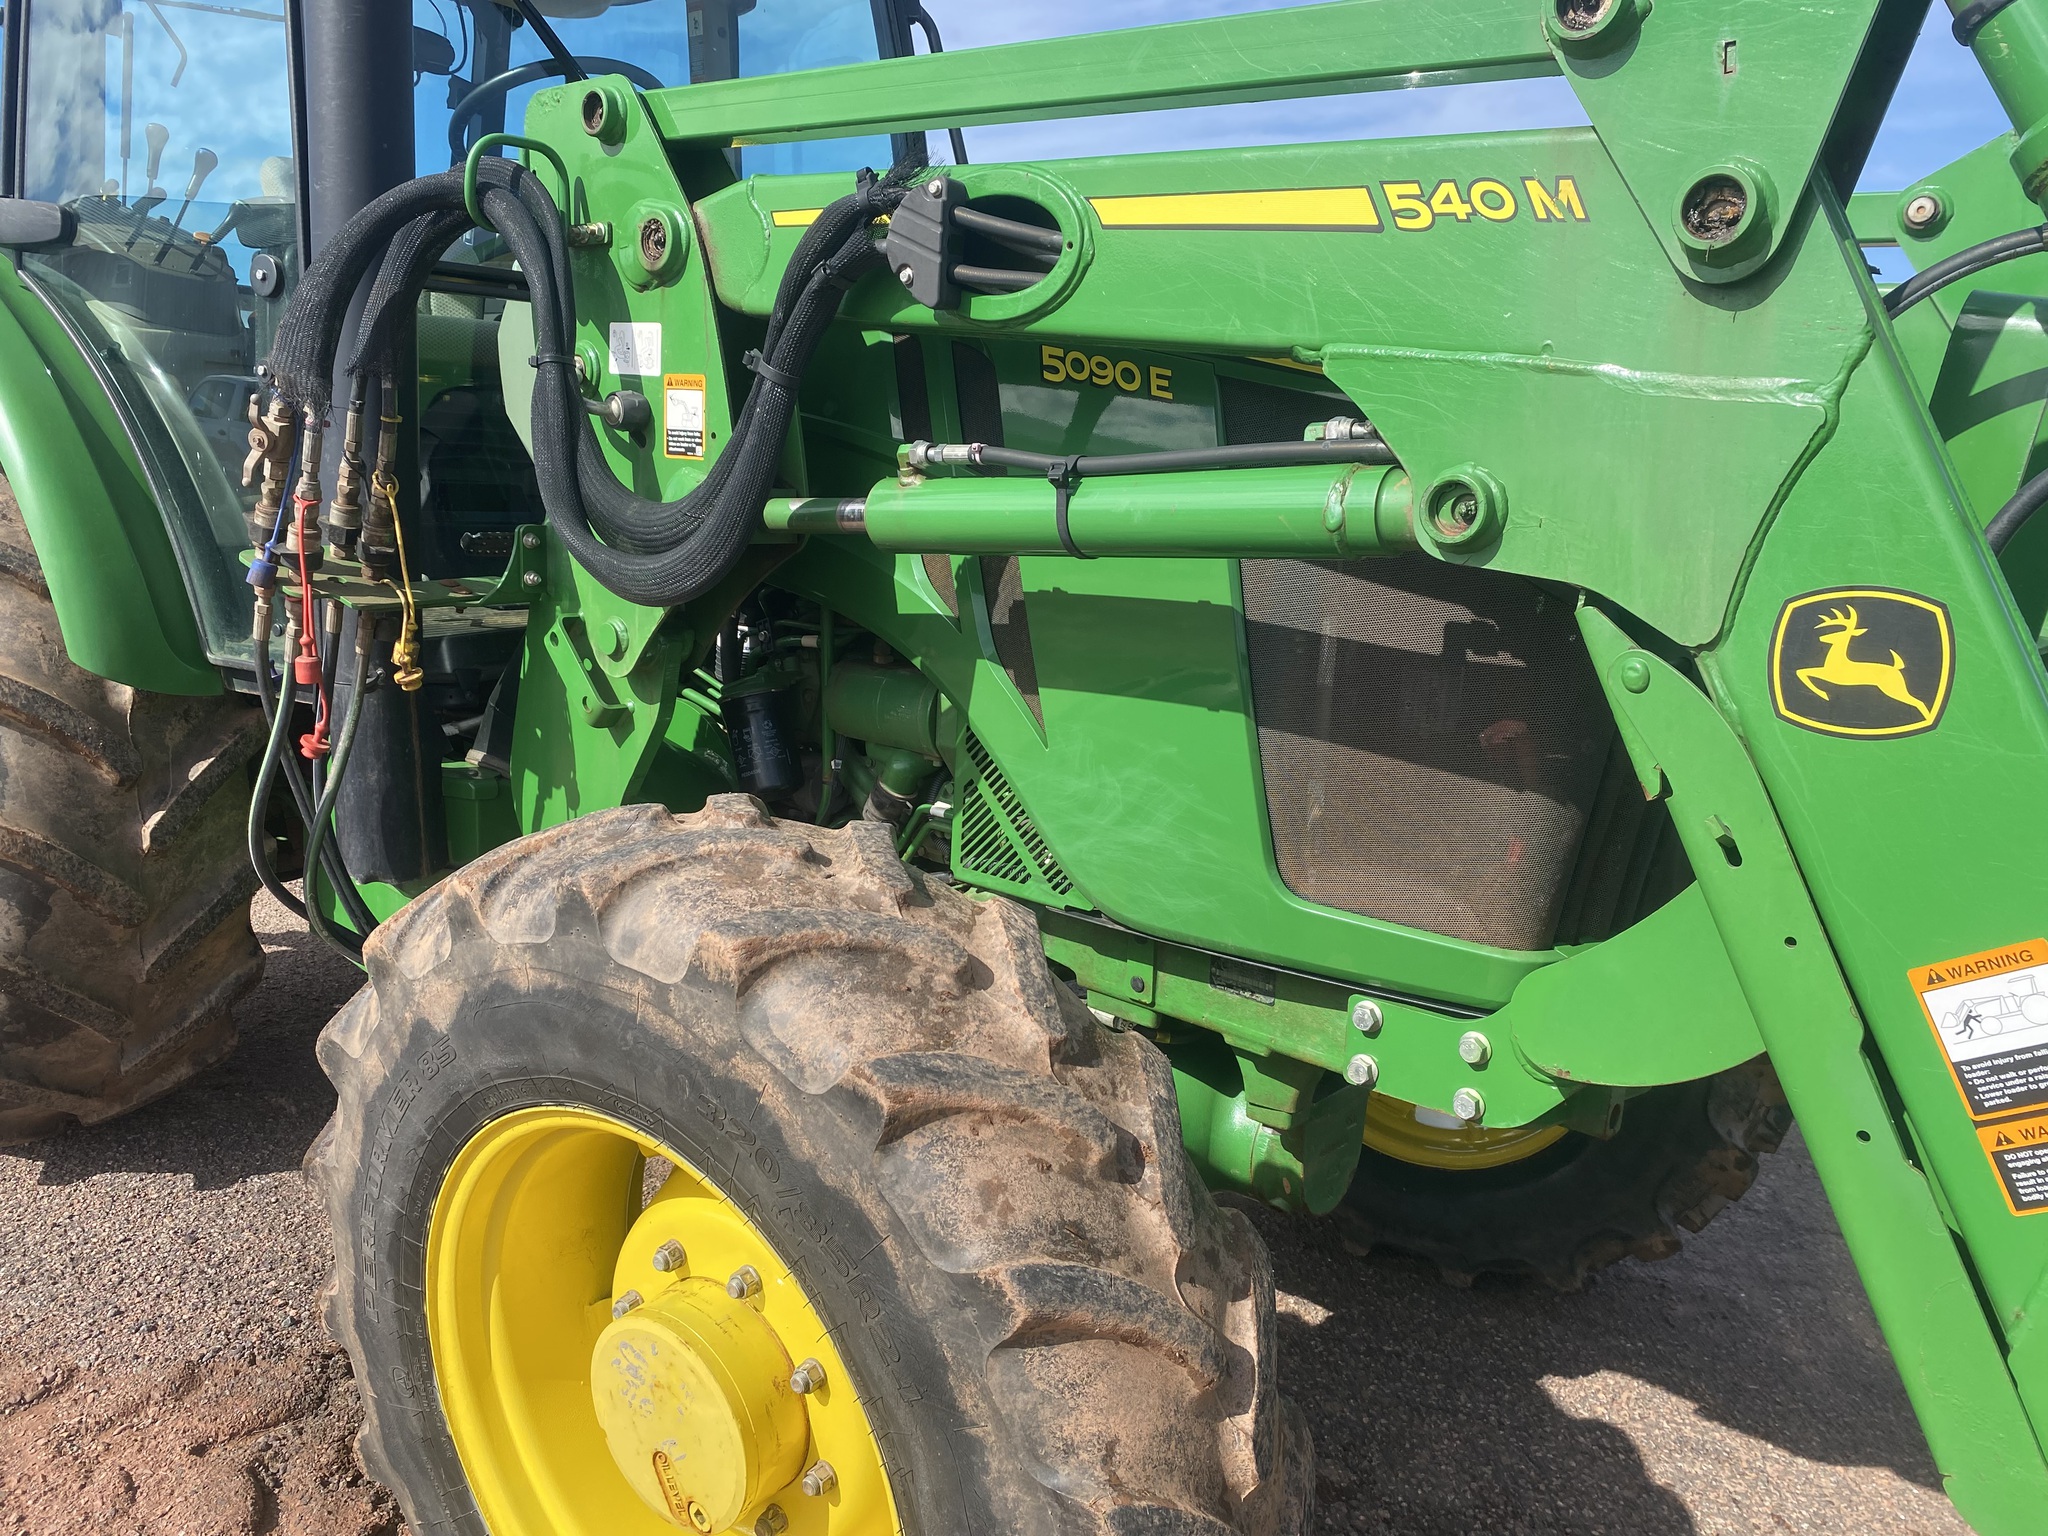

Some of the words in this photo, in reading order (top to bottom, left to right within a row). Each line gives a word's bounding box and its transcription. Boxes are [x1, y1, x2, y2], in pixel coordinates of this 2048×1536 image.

[1379, 177, 1518, 232] 540
[1520, 175, 1590, 222] M
[1042, 345, 1141, 391] 5090
[1149, 366, 1173, 399] E
[674, 378, 703, 388] WARNING
[1946, 949, 2034, 980] WARNING
[1972, 1061, 1992, 1070] avoid
[1993, 1056, 2014, 1065] injury
[2014, 1052, 2033, 1061] from
[1964, 1069, 1991, 1079] loader:
[1977, 1082, 2004, 1092] service
[2005, 1077, 2027, 1086] under
[1979, 1091, 2003, 1099] Lower
[2004, 1085, 2027, 1095] loader
[1984, 1096, 2012, 1107] parked.
[2018, 1150, 2033, 1159] NOT
[2008, 1158, 2041, 1168] engaging
[360, 1070, 423, 1323] PERFORMER
[420, 1035, 458, 1081] 85
[2012, 1171, 2037, 1180] Failure
[2015, 1179, 2036, 1187] result
[2018, 1187, 2037, 1195] from
[2021, 1193, 2044, 1202] bodily
[657, 1452, 671, 1474] OIL
[666, 1475, 686, 1516] LEVEL
